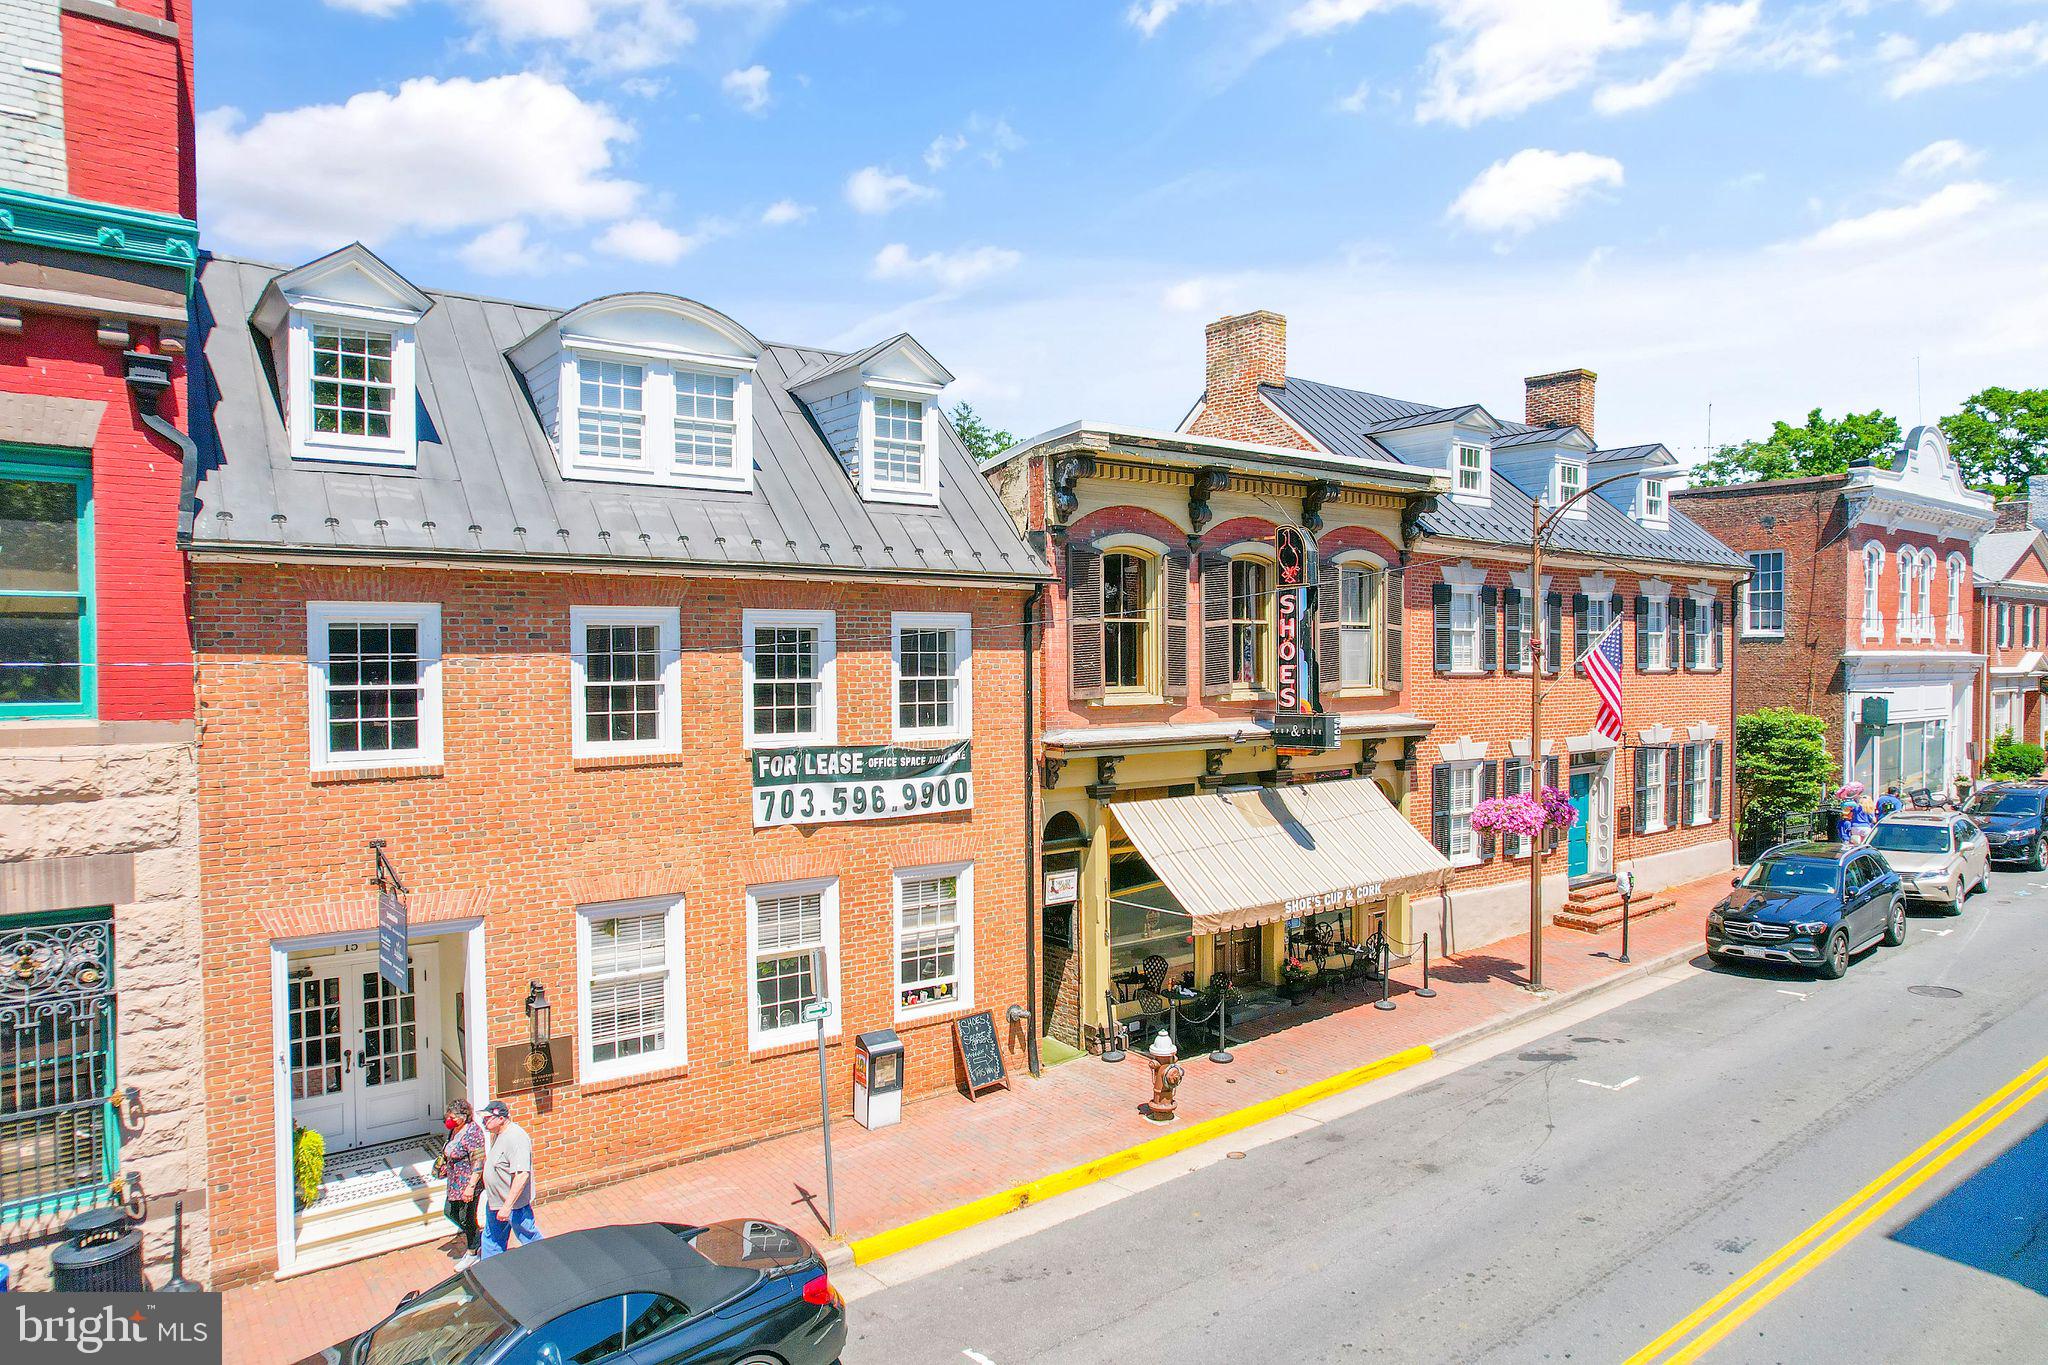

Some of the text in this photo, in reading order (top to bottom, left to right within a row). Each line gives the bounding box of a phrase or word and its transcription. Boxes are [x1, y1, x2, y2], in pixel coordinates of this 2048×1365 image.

[1279, 594, 1296, 708] SHOES
[1291, 724, 1301, 737] &
[758, 751, 966, 778] FOR LEASE OFFICE SPACE AVAILLE
[760, 777, 968, 822] 703.596.9900
[1284, 883, 1382, 914] SHOE'S CUP & CORK
